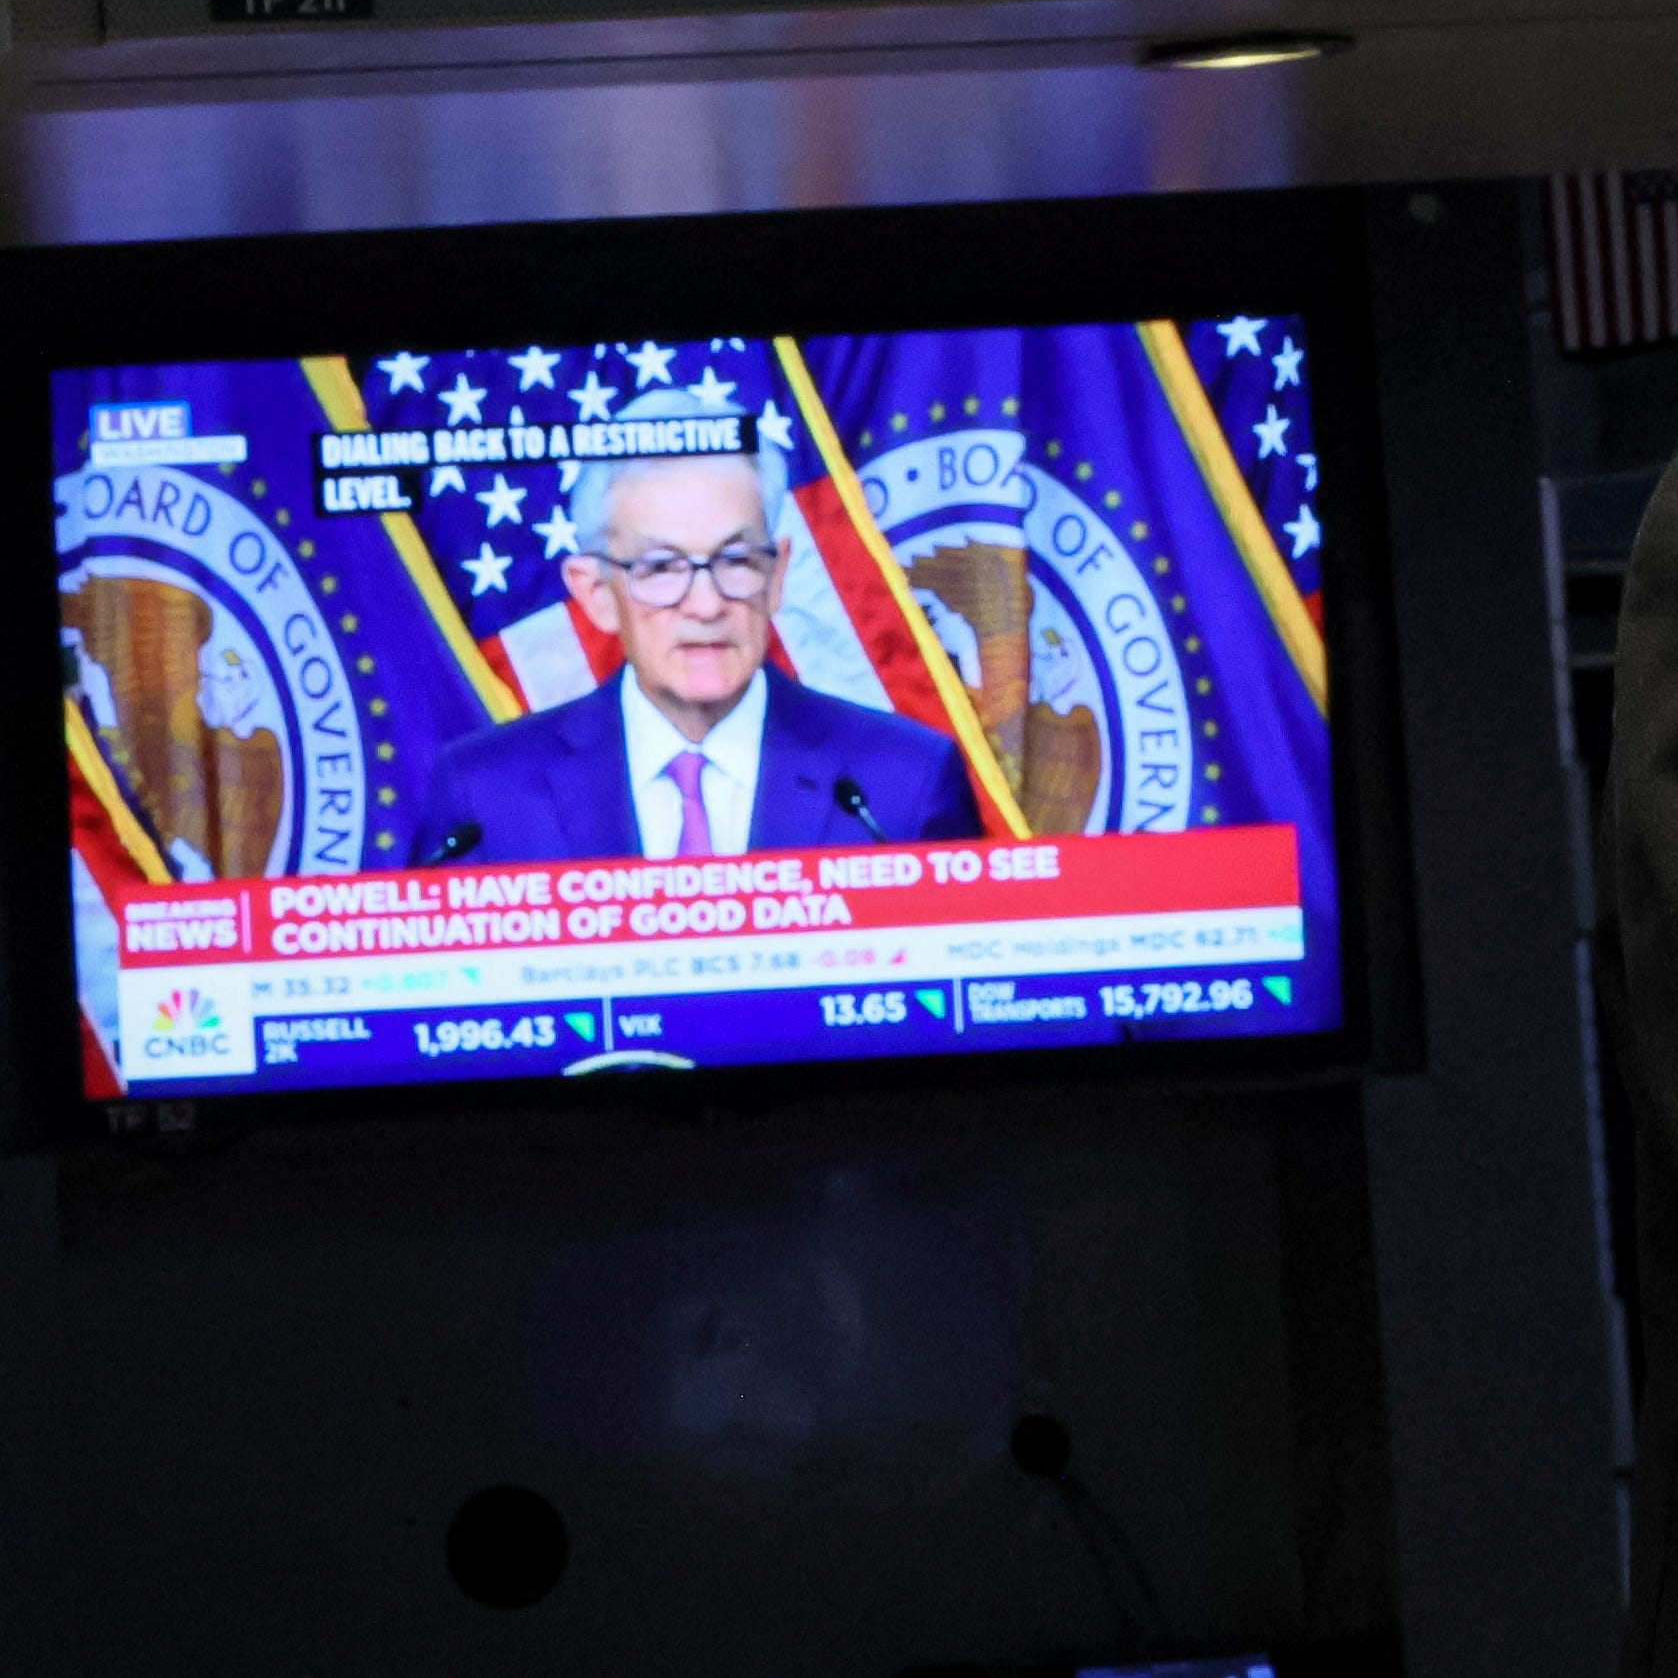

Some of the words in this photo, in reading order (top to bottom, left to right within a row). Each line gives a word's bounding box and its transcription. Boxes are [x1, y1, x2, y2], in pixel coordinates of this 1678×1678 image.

[100, 407, 183, 440] LIVE
[322, 433, 429, 468] DIALING
[434, 429, 506, 463] BACK
[511, 427, 545, 459] TO
[550, 427, 570, 458] A
[573, 418, 741, 456] RESTRICTIVE
[323, 476, 411, 511] LEVEL.
[271, 884, 441, 920] POWELL:
[449, 872, 552, 909] HAVE
[558, 860, 813, 903] CONFIDENCE,
[819, 852, 922, 890] NEED
[928, 850, 981, 883] TO
[989, 846, 1060, 880] SEE
[126, 921, 237, 952] NEWS
[271, 909, 561, 956] CONTINUATION
[567, 906, 622, 940] OF
[630, 899, 746, 936] GOOD
[753, 895, 852, 930] DATA
[820, 992, 906, 1026] 13.65
[1099, 978, 1253, 1019] 15,792.96
[145, 1034, 230, 1059] CNBC
[414, 1015, 556, 1057] 1,996.43
